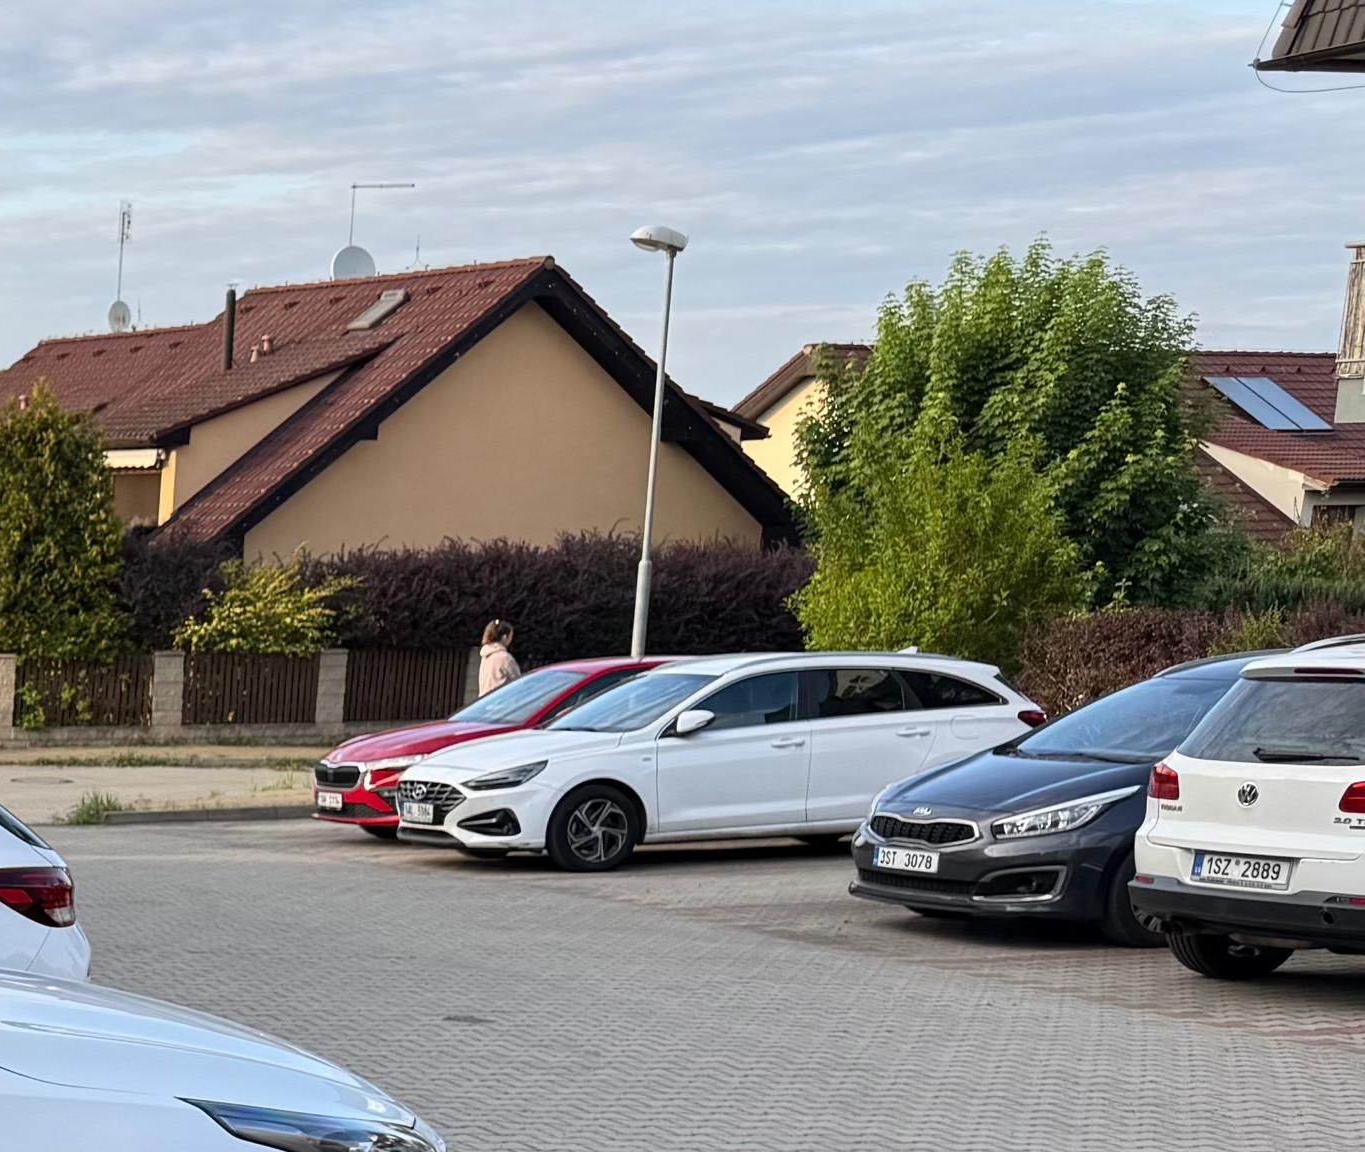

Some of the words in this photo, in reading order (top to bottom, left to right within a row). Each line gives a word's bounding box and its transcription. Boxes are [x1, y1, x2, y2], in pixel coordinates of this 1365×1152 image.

[880, 849, 897, 865] 3ST
[904, 853, 933, 870] 3078
[1207, 856, 1231, 876] 1SZ
[1241, 860, 1281, 880] 2889
